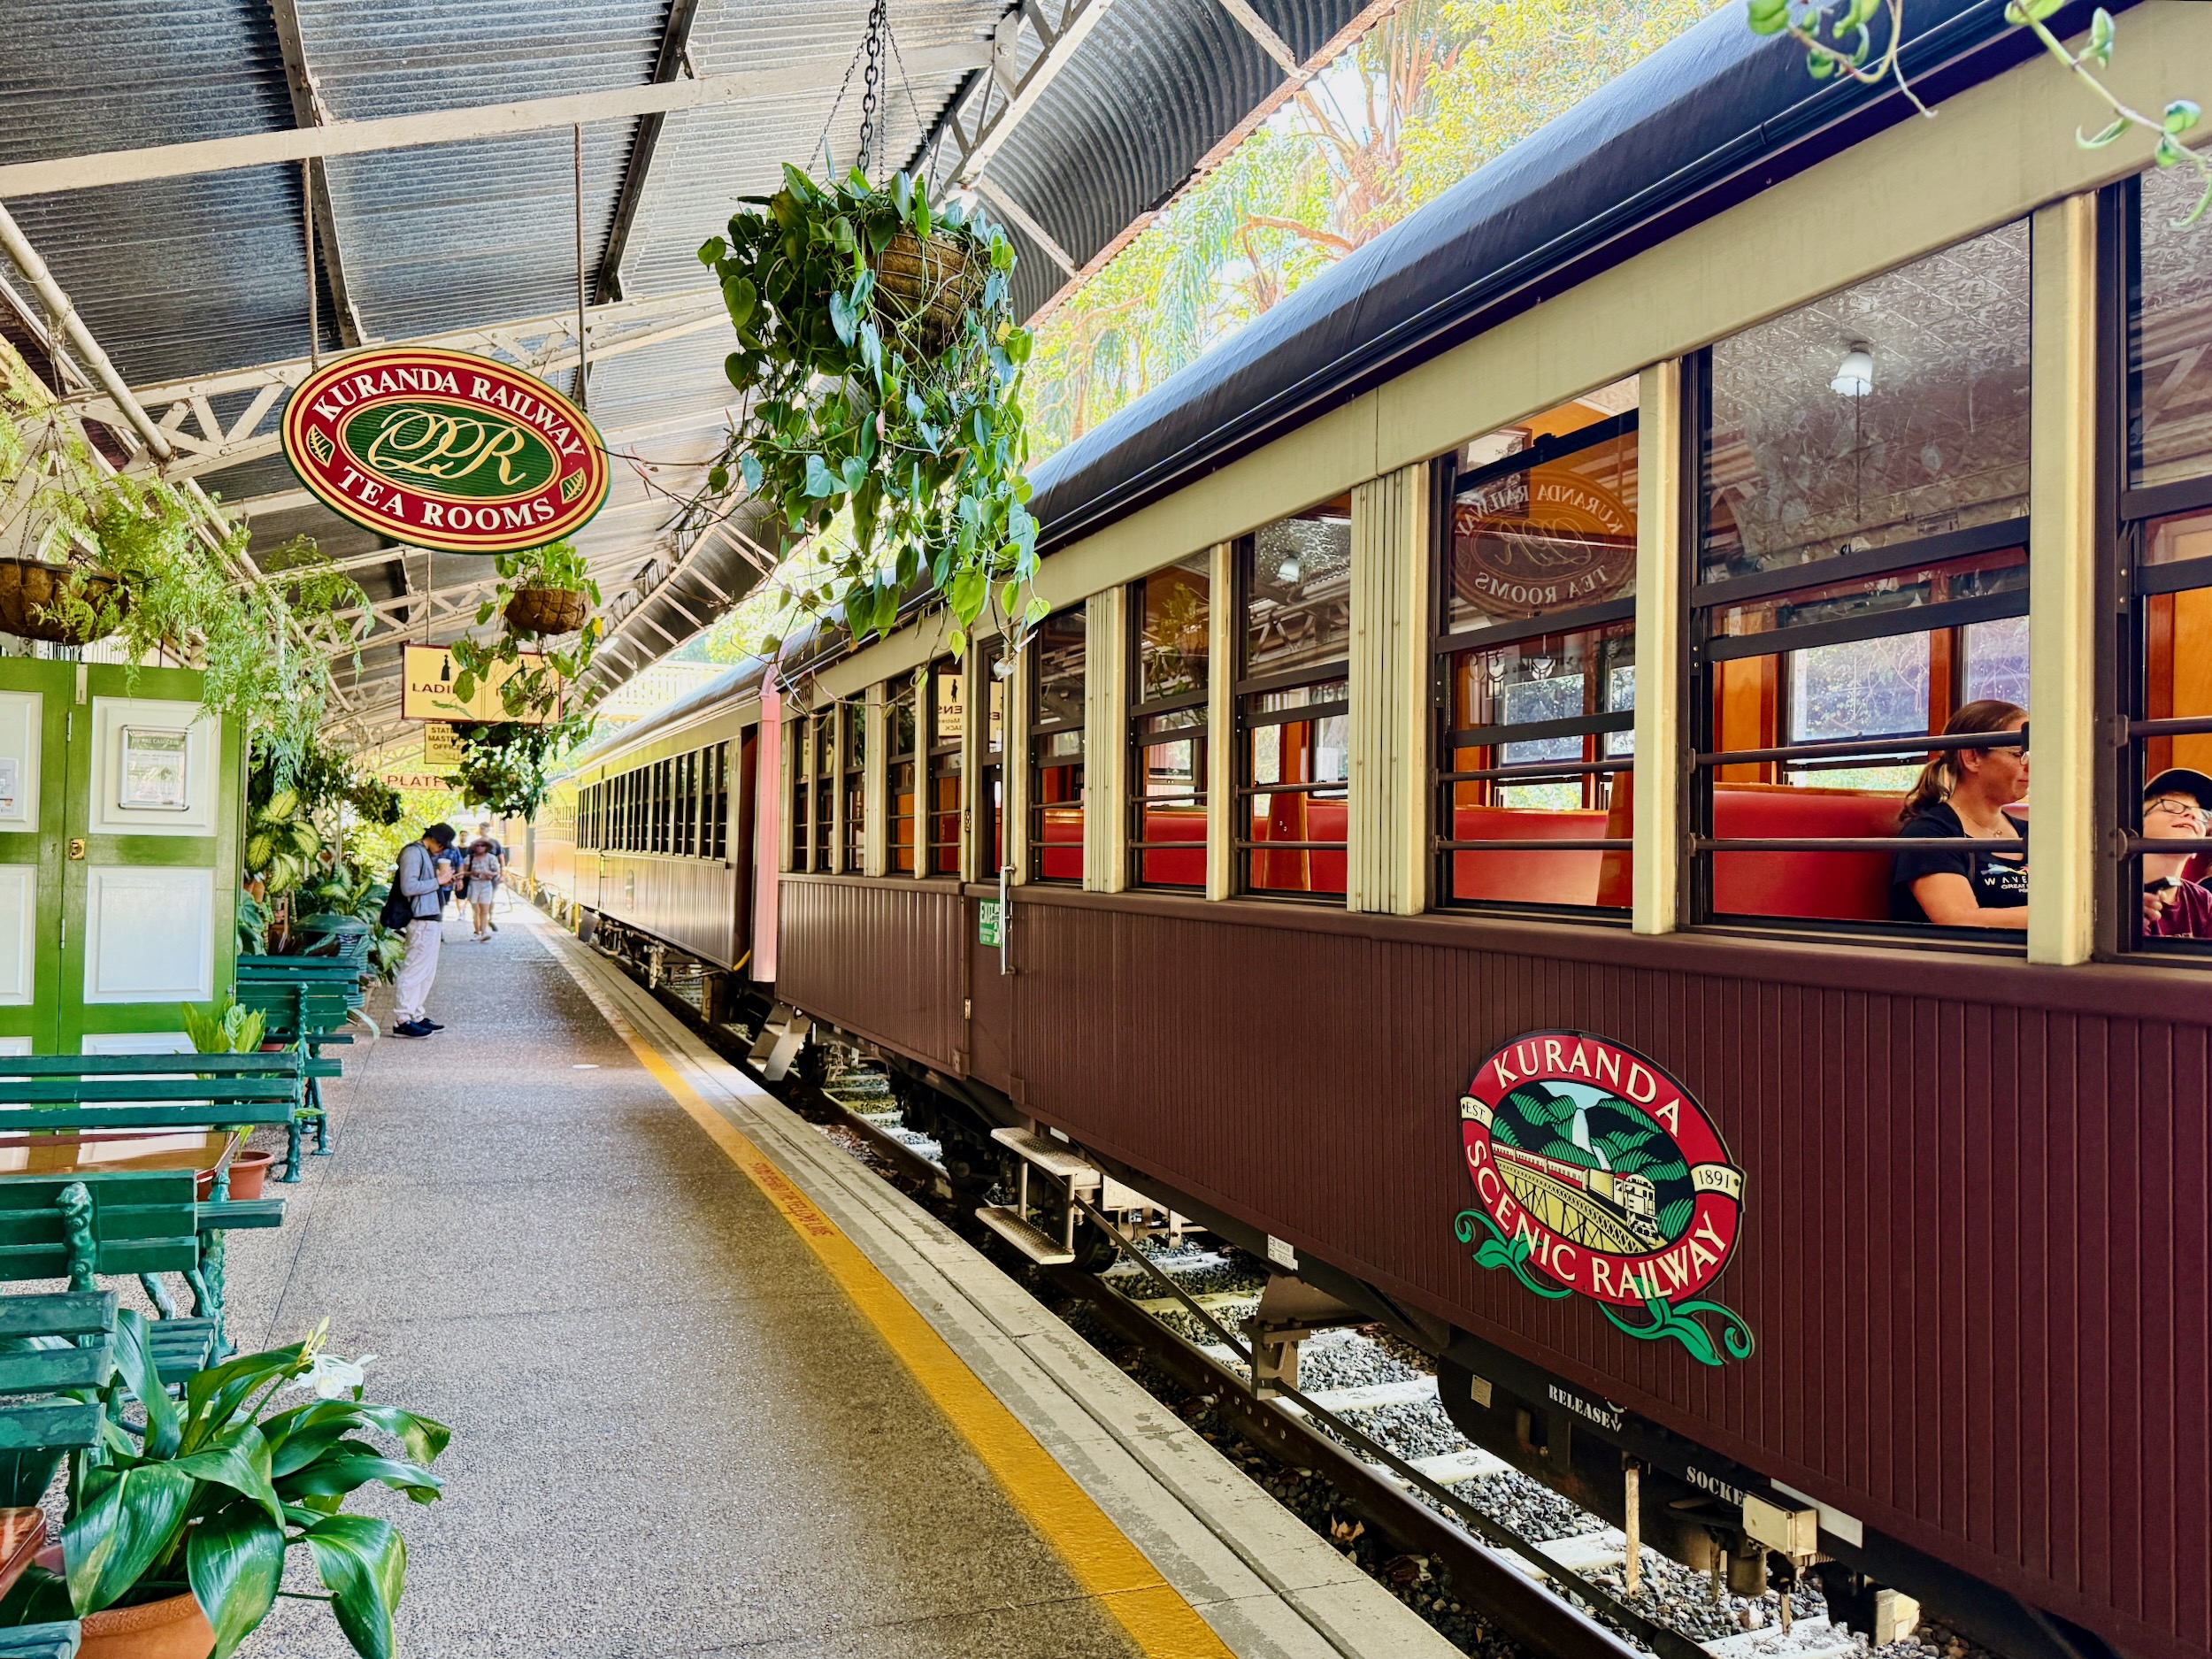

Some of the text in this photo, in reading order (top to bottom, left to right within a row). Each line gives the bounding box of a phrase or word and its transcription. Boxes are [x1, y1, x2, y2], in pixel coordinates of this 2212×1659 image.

[312, 368, 586, 458] KURANDA RAILWAY
[337, 465, 556, 531] TEA ROOMS
[1466, 1102, 1486, 1121] EST.
[1492, 1039, 1680, 1137] KURANDA
[1699, 1168, 1731, 1190] 1891
[1467, 1139, 1727, 1300] SCENIC RAILWAY
[1548, 1383, 1611, 1429] RELEASE
[1686, 1465, 1743, 1509] SOCKE
